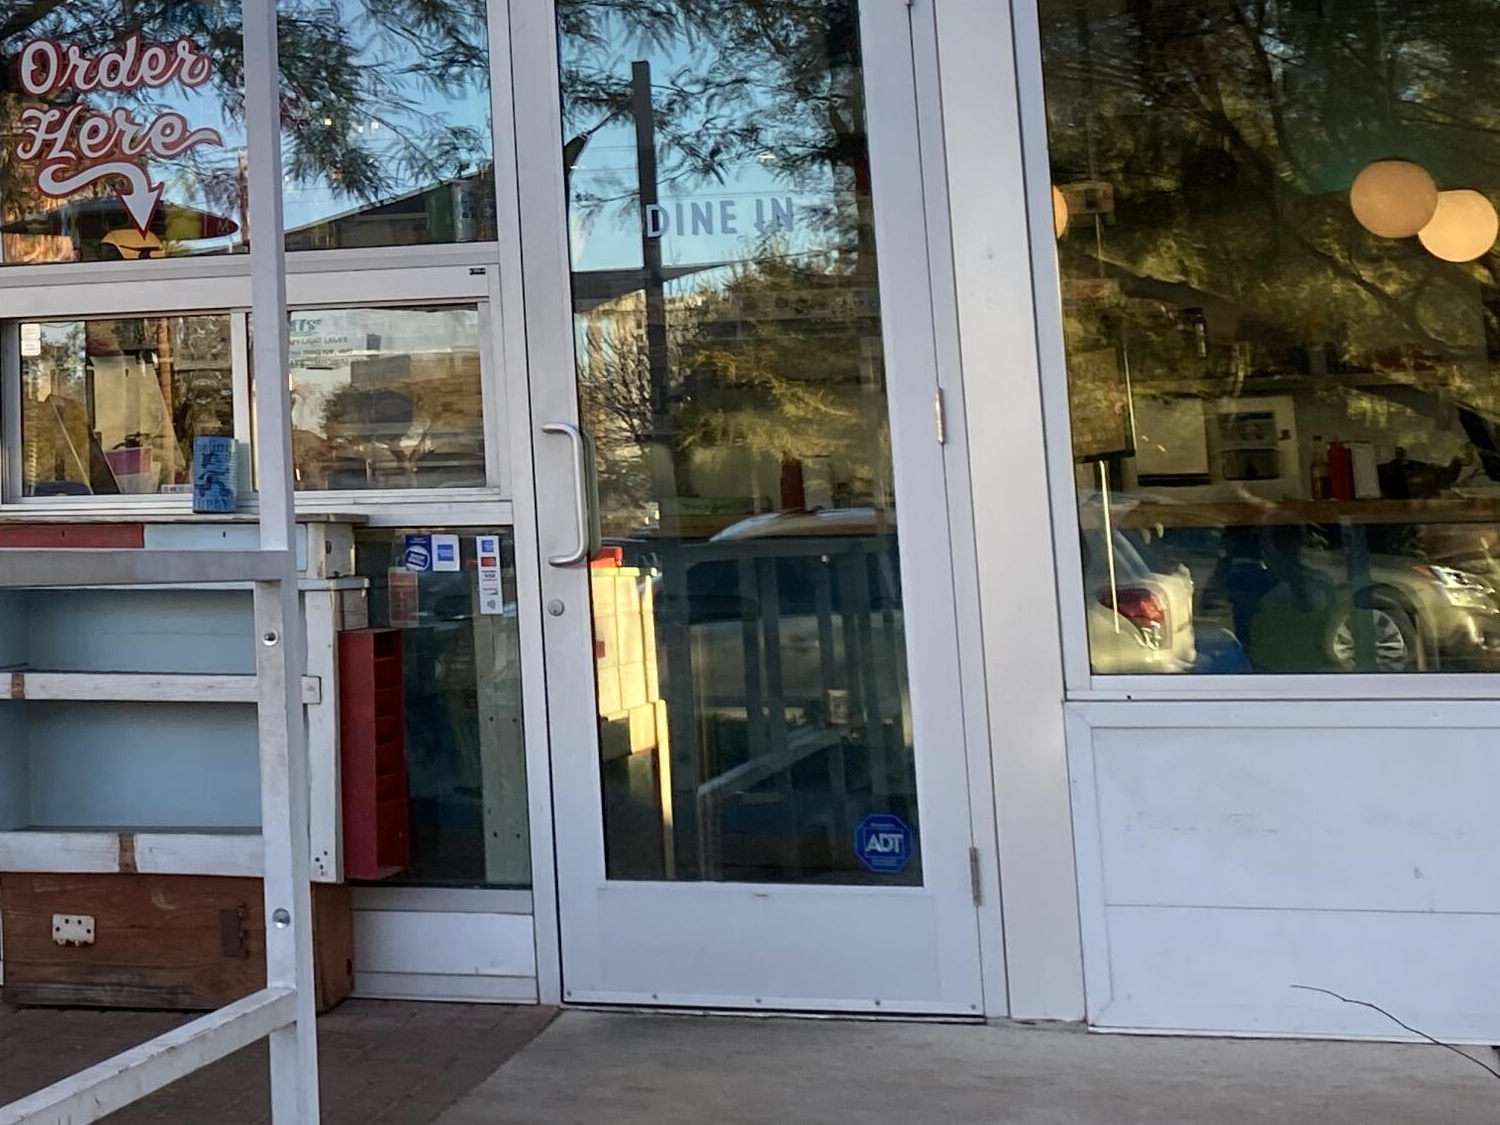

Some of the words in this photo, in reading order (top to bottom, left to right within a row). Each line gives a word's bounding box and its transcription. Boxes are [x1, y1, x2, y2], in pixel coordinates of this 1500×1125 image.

[19, 32, 212, 96] Order
[15, 103, 224, 161] Here
[646, 200, 738, 237] DINE
[755, 196, 795, 232] IN
[865, 833, 904, 853] ADT
